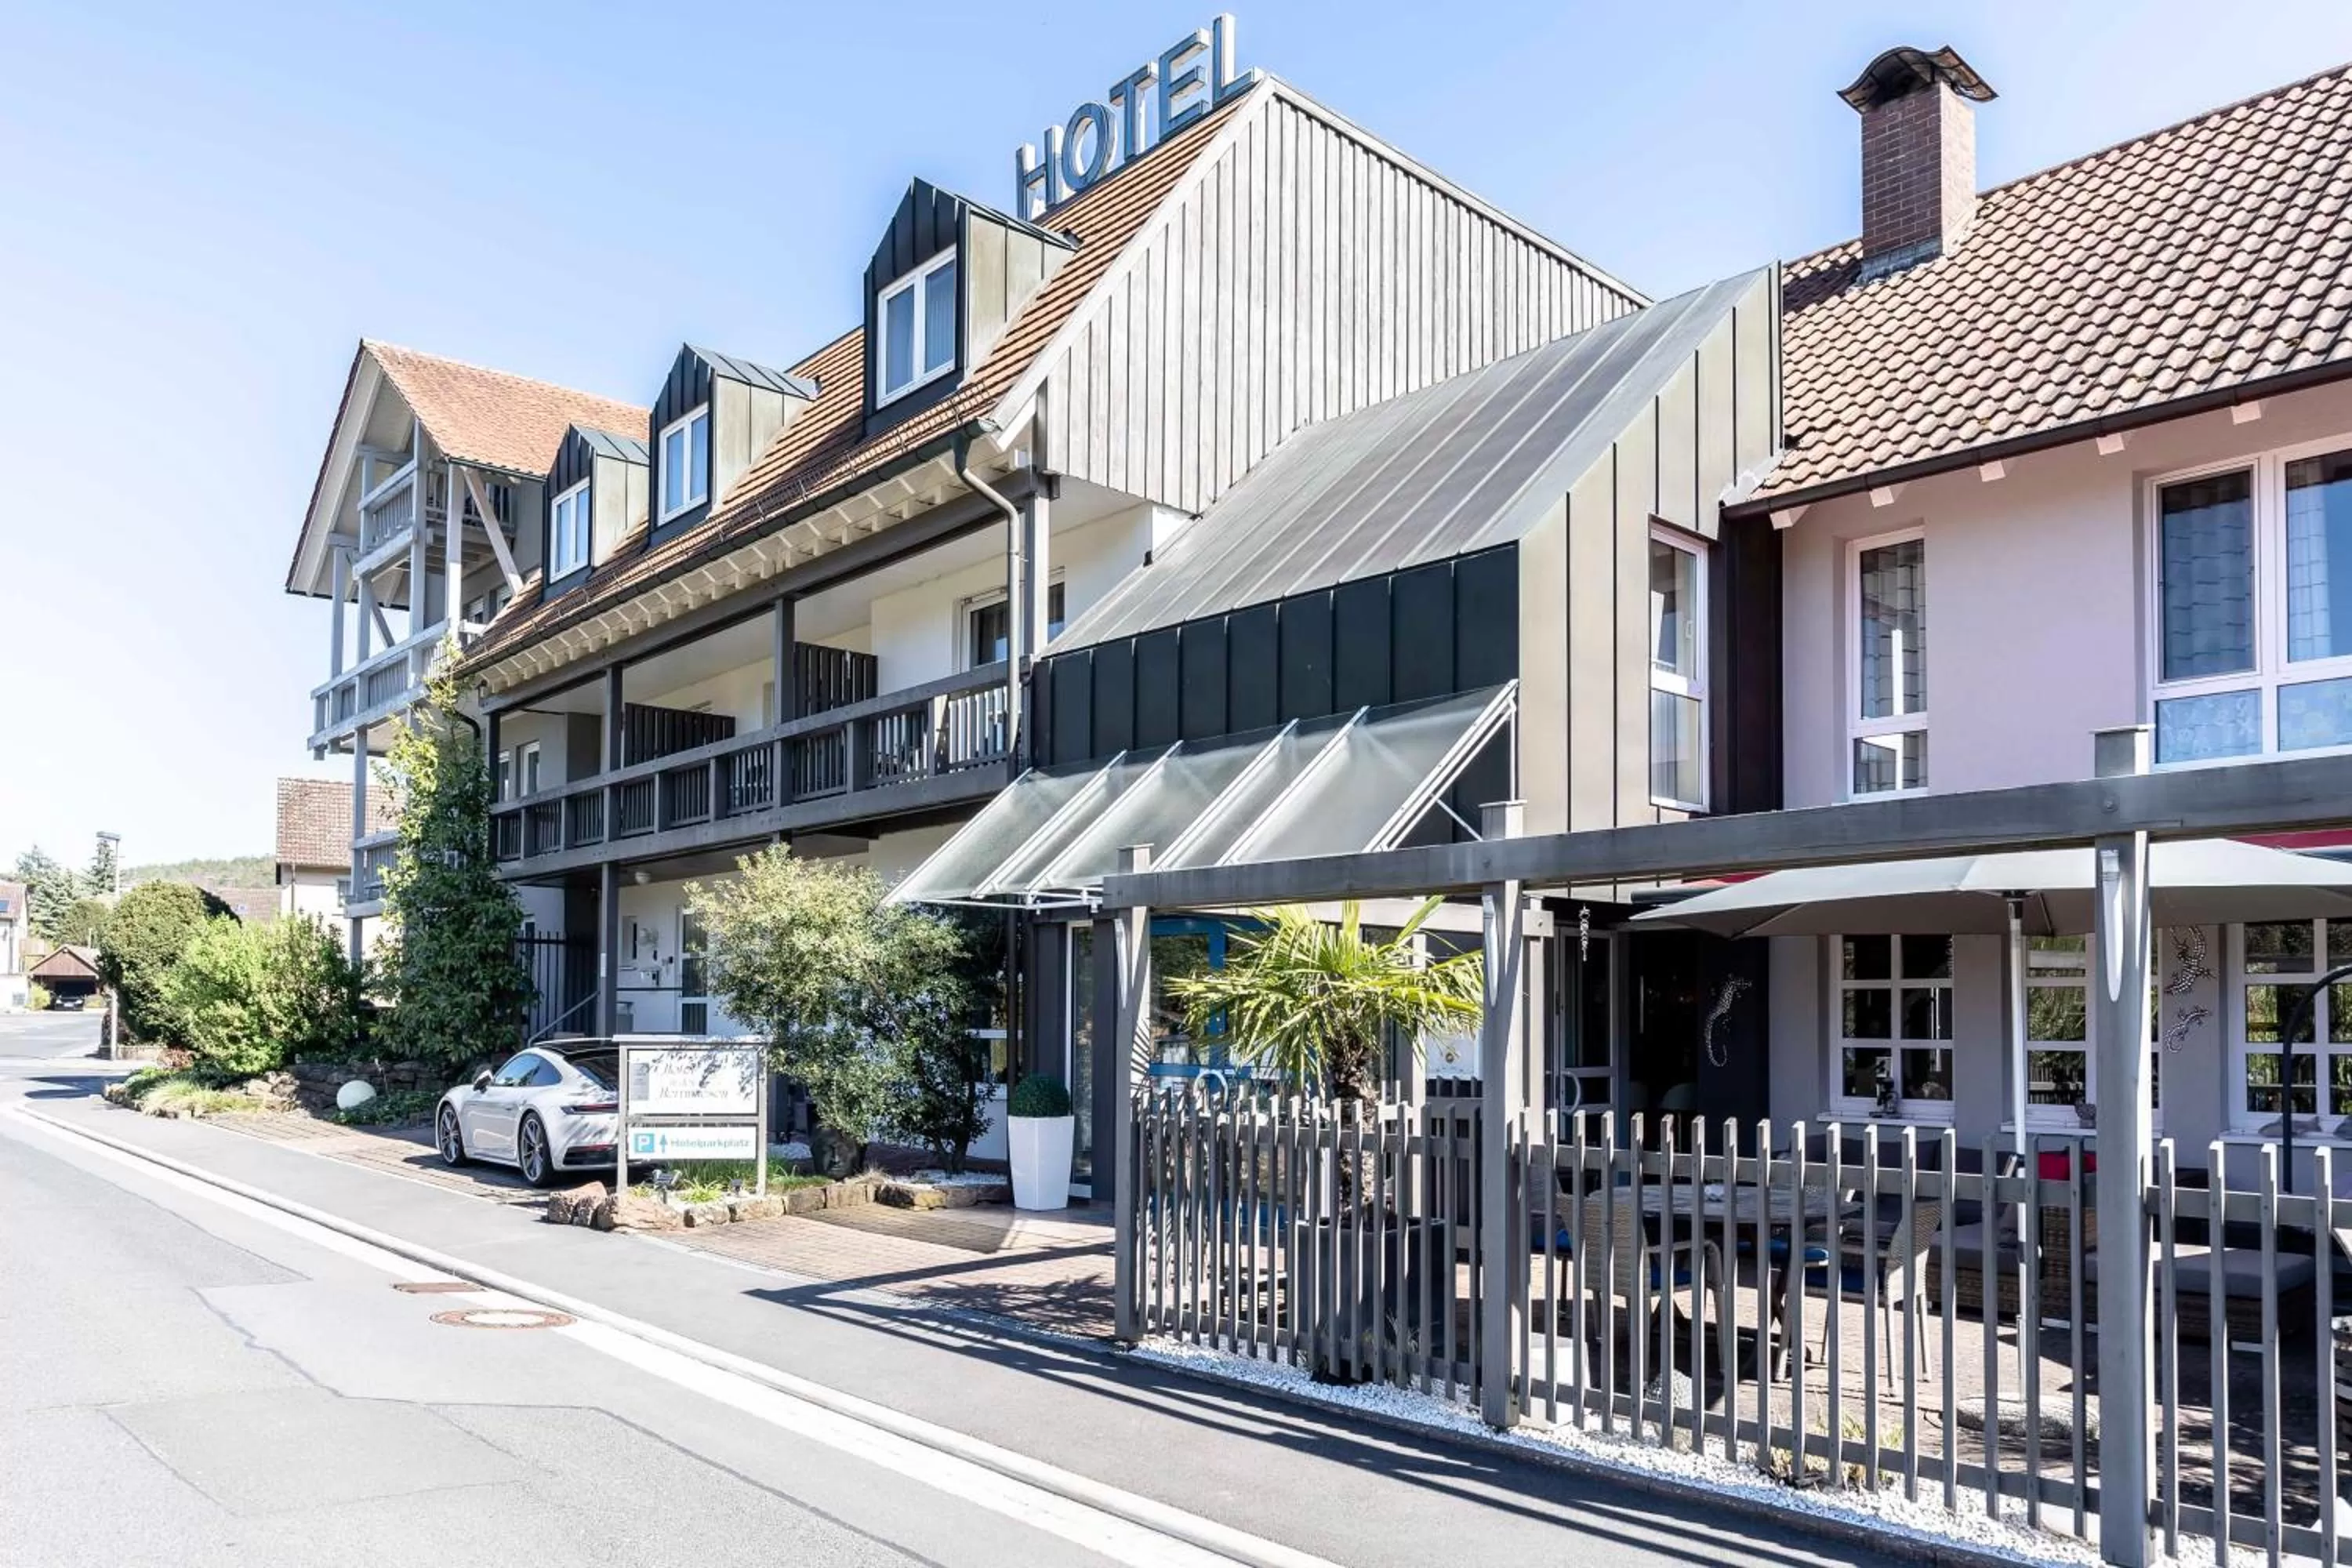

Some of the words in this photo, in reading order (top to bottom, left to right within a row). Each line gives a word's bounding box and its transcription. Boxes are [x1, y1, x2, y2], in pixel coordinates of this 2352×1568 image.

[1016, 13, 1263, 220] HOTEL
[637, 1134, 650, 1152] P
[670, 1138, 750, 1149] Hotelparkplatz
